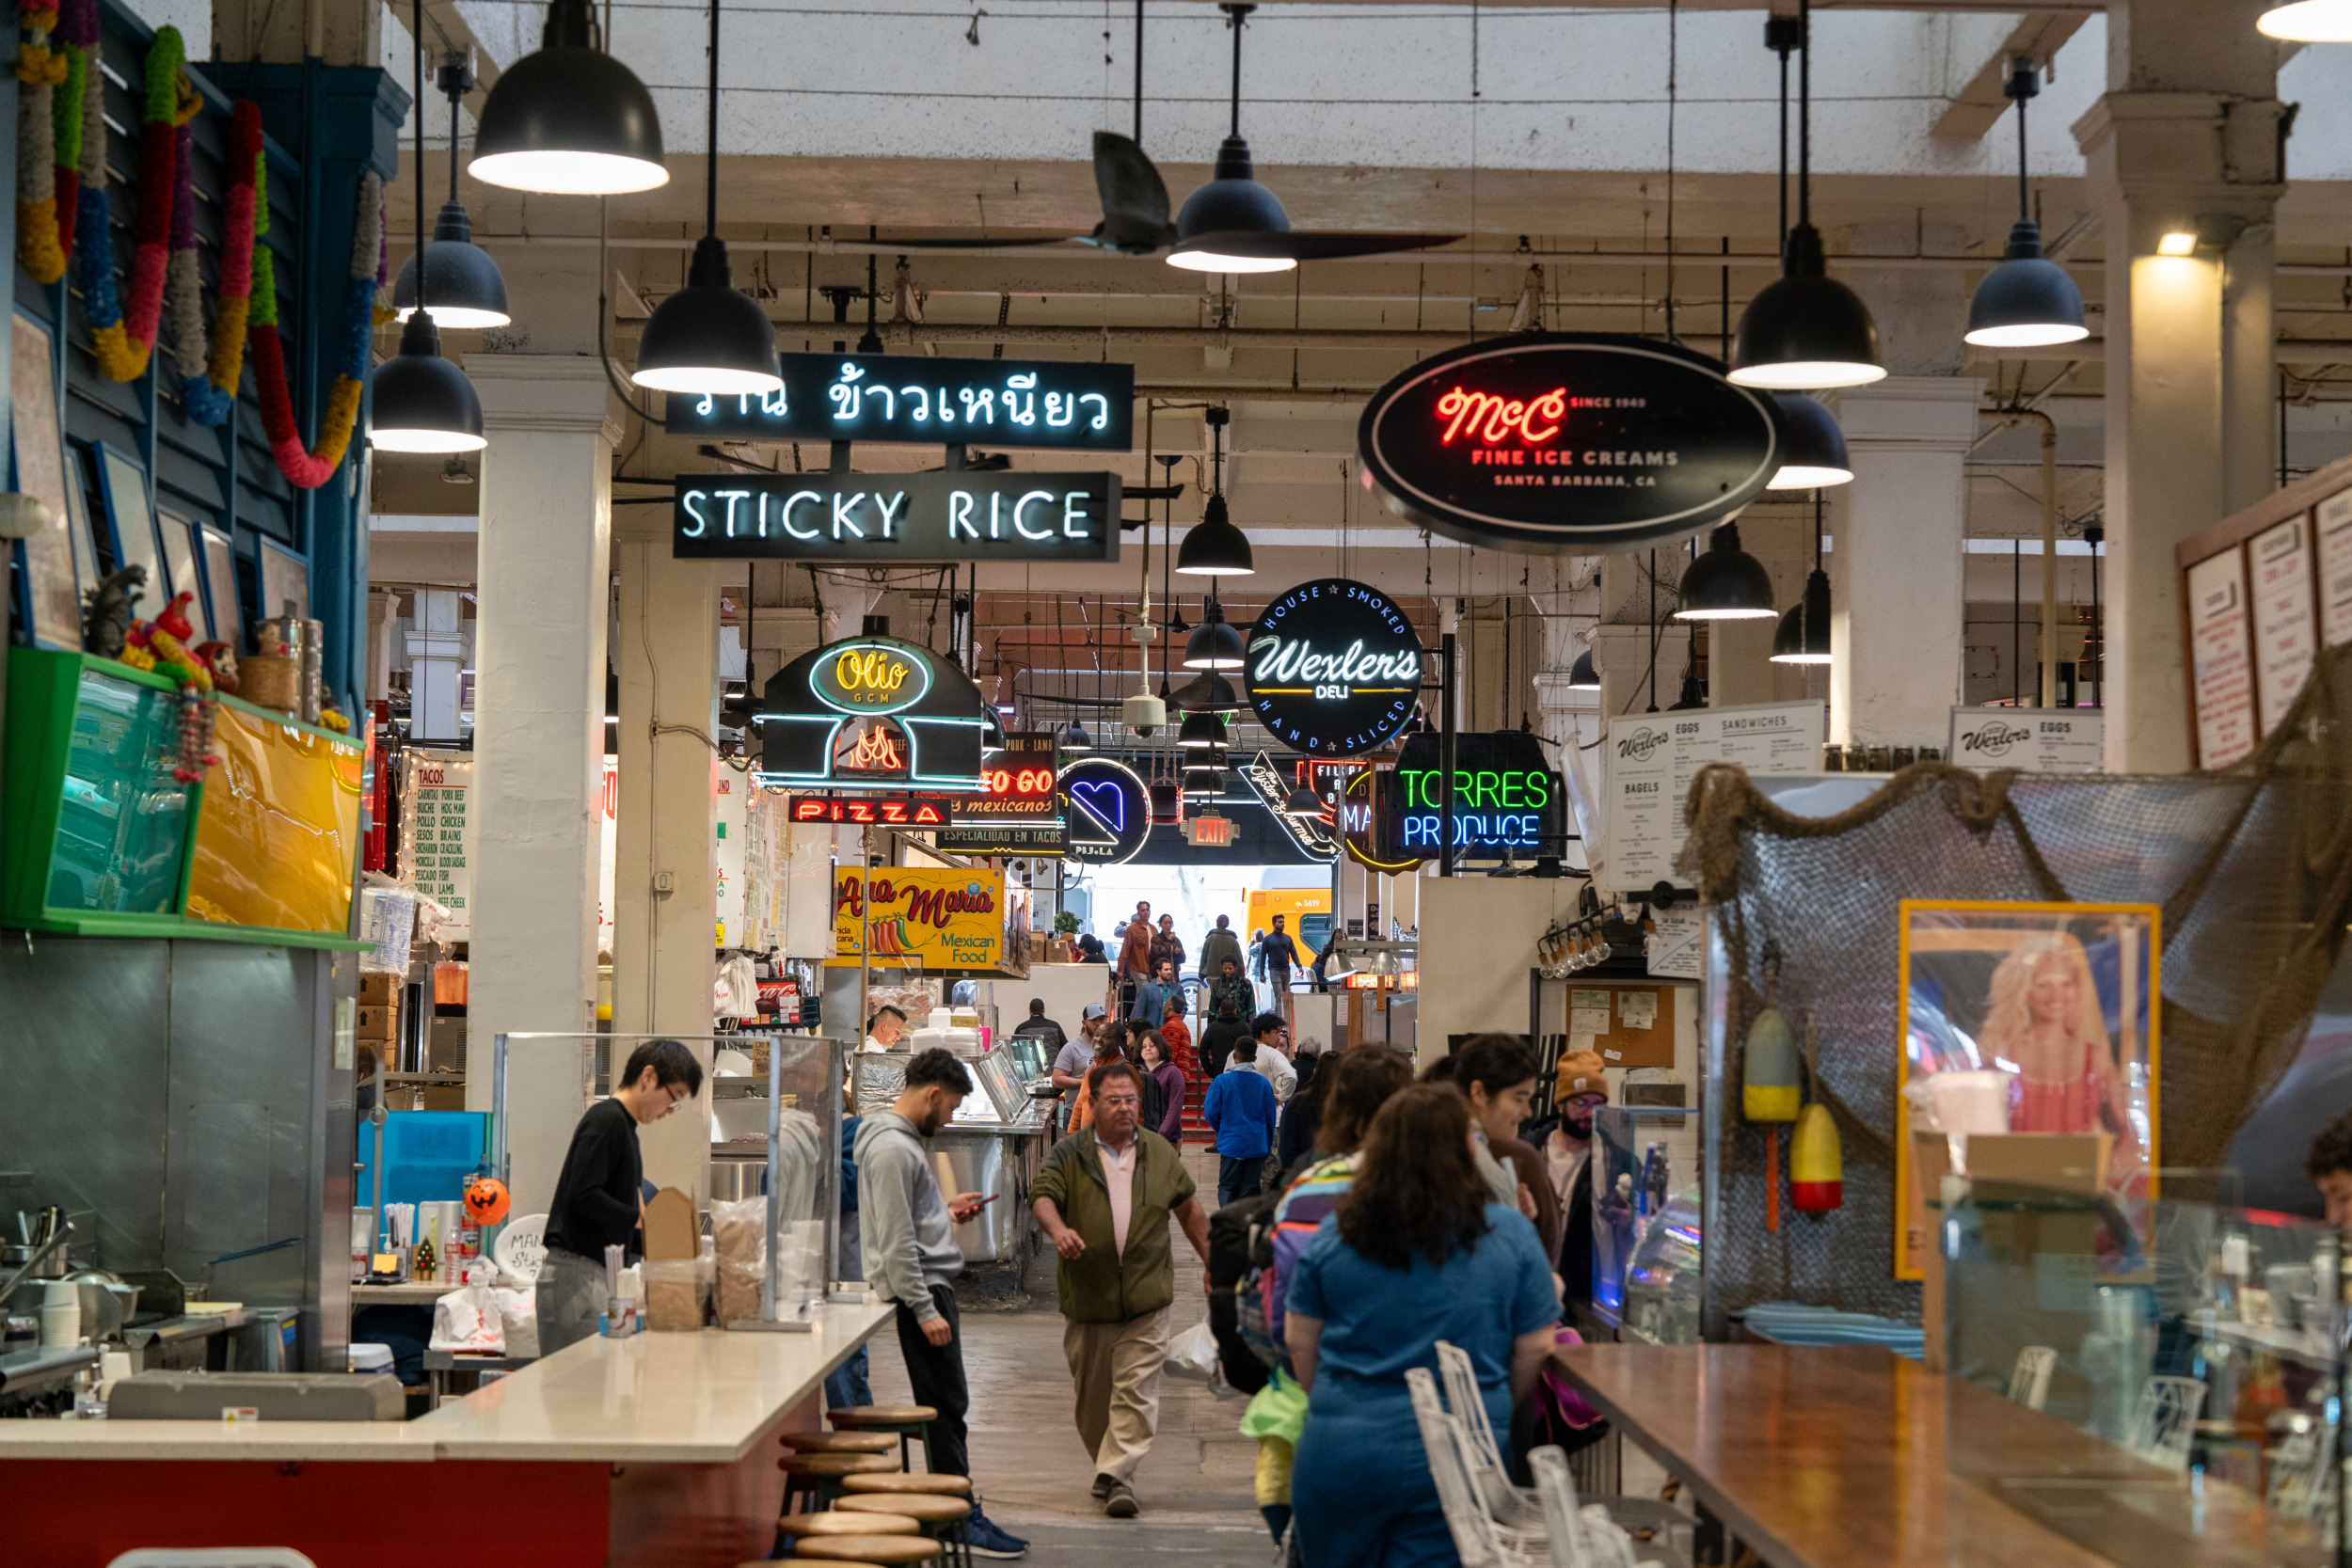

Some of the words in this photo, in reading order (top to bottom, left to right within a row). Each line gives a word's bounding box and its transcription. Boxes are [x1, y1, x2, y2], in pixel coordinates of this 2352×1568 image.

[829, 362, 1108, 430] ข้าวเหนียว
[1436, 387, 1567, 444] McC
[1569, 397, 1612, 408] SINCE
[1470, 450, 1526, 466] FINE
[1534, 451, 1573, 466] ICE
[1582, 451, 1679, 467] CREAMS
[1494, 475, 1546, 486] SANTA
[1551, 475, 1631, 488] BARBARA,
[1635, 476, 1657, 487] CA
[682, 490, 905, 540] STICKY
[948, 490, 1091, 541] RICE
[1264, 586, 1320, 629] HOUSE
[1347, 587, 1406, 634] SMOKED
[1248, 635, 1420, 682] Wexler's
[836, 648, 909, 690] Olio
[1315, 684, 1349, 700] DELI
[1260, 700, 1319, 749] HAND
[1346, 700, 1406, 749] SLICED
[1676, 722, 1700, 734] EGGS
[1722, 715, 1787, 730] SANDWICHES
[2040, 721, 2072, 733] EGGS
[1006, 738, 1025, 752] PORK
[1033, 738, 1053, 752] LAMB
[418, 768, 444, 784] TACOS
[1016, 768, 1054, 793] GO
[417, 789, 438, 800] CARNITAS
[441, 789, 453, 800] PORK
[454, 790, 465, 800] BEEF
[1624, 782, 1660, 794] BAGELS
[417, 802, 435, 814] BUCHE
[441, 802, 453, 814] HOG
[453, 803, 467, 814] MAW
[795, 800, 946, 823] PIZZA
[966, 798, 1053, 813] mexicanos
[417, 816, 436, 827] POLLO
[440, 816, 466, 828] CHICKEN
[416, 829, 434, 841] SESOS
[440, 830, 461, 841] BRAINS
[944, 831, 1010, 841] ESPECIALIDAD
[1014, 831, 1027, 842] EN
[1033, 831, 1062, 843] TACOS
[1196, 819, 1227, 844] EXIT
[439, 843, 463, 854] CRACKLING
[415, 856, 436, 867] MORCILLA
[415, 870, 437, 880] PESCADO
[438, 870, 450, 881] FISH
[438, 883, 454, 895] LAMB
[450, 897, 466, 909] CHEEK
[837, 876, 898, 917] Ana
[899, 883, 994, 928] Maria
[1303, 899, 1320, 908] 5619
[941, 933, 995, 947] Mexican
[952, 948, 987, 963] Food
[510, 1234, 543, 1249] MAN
